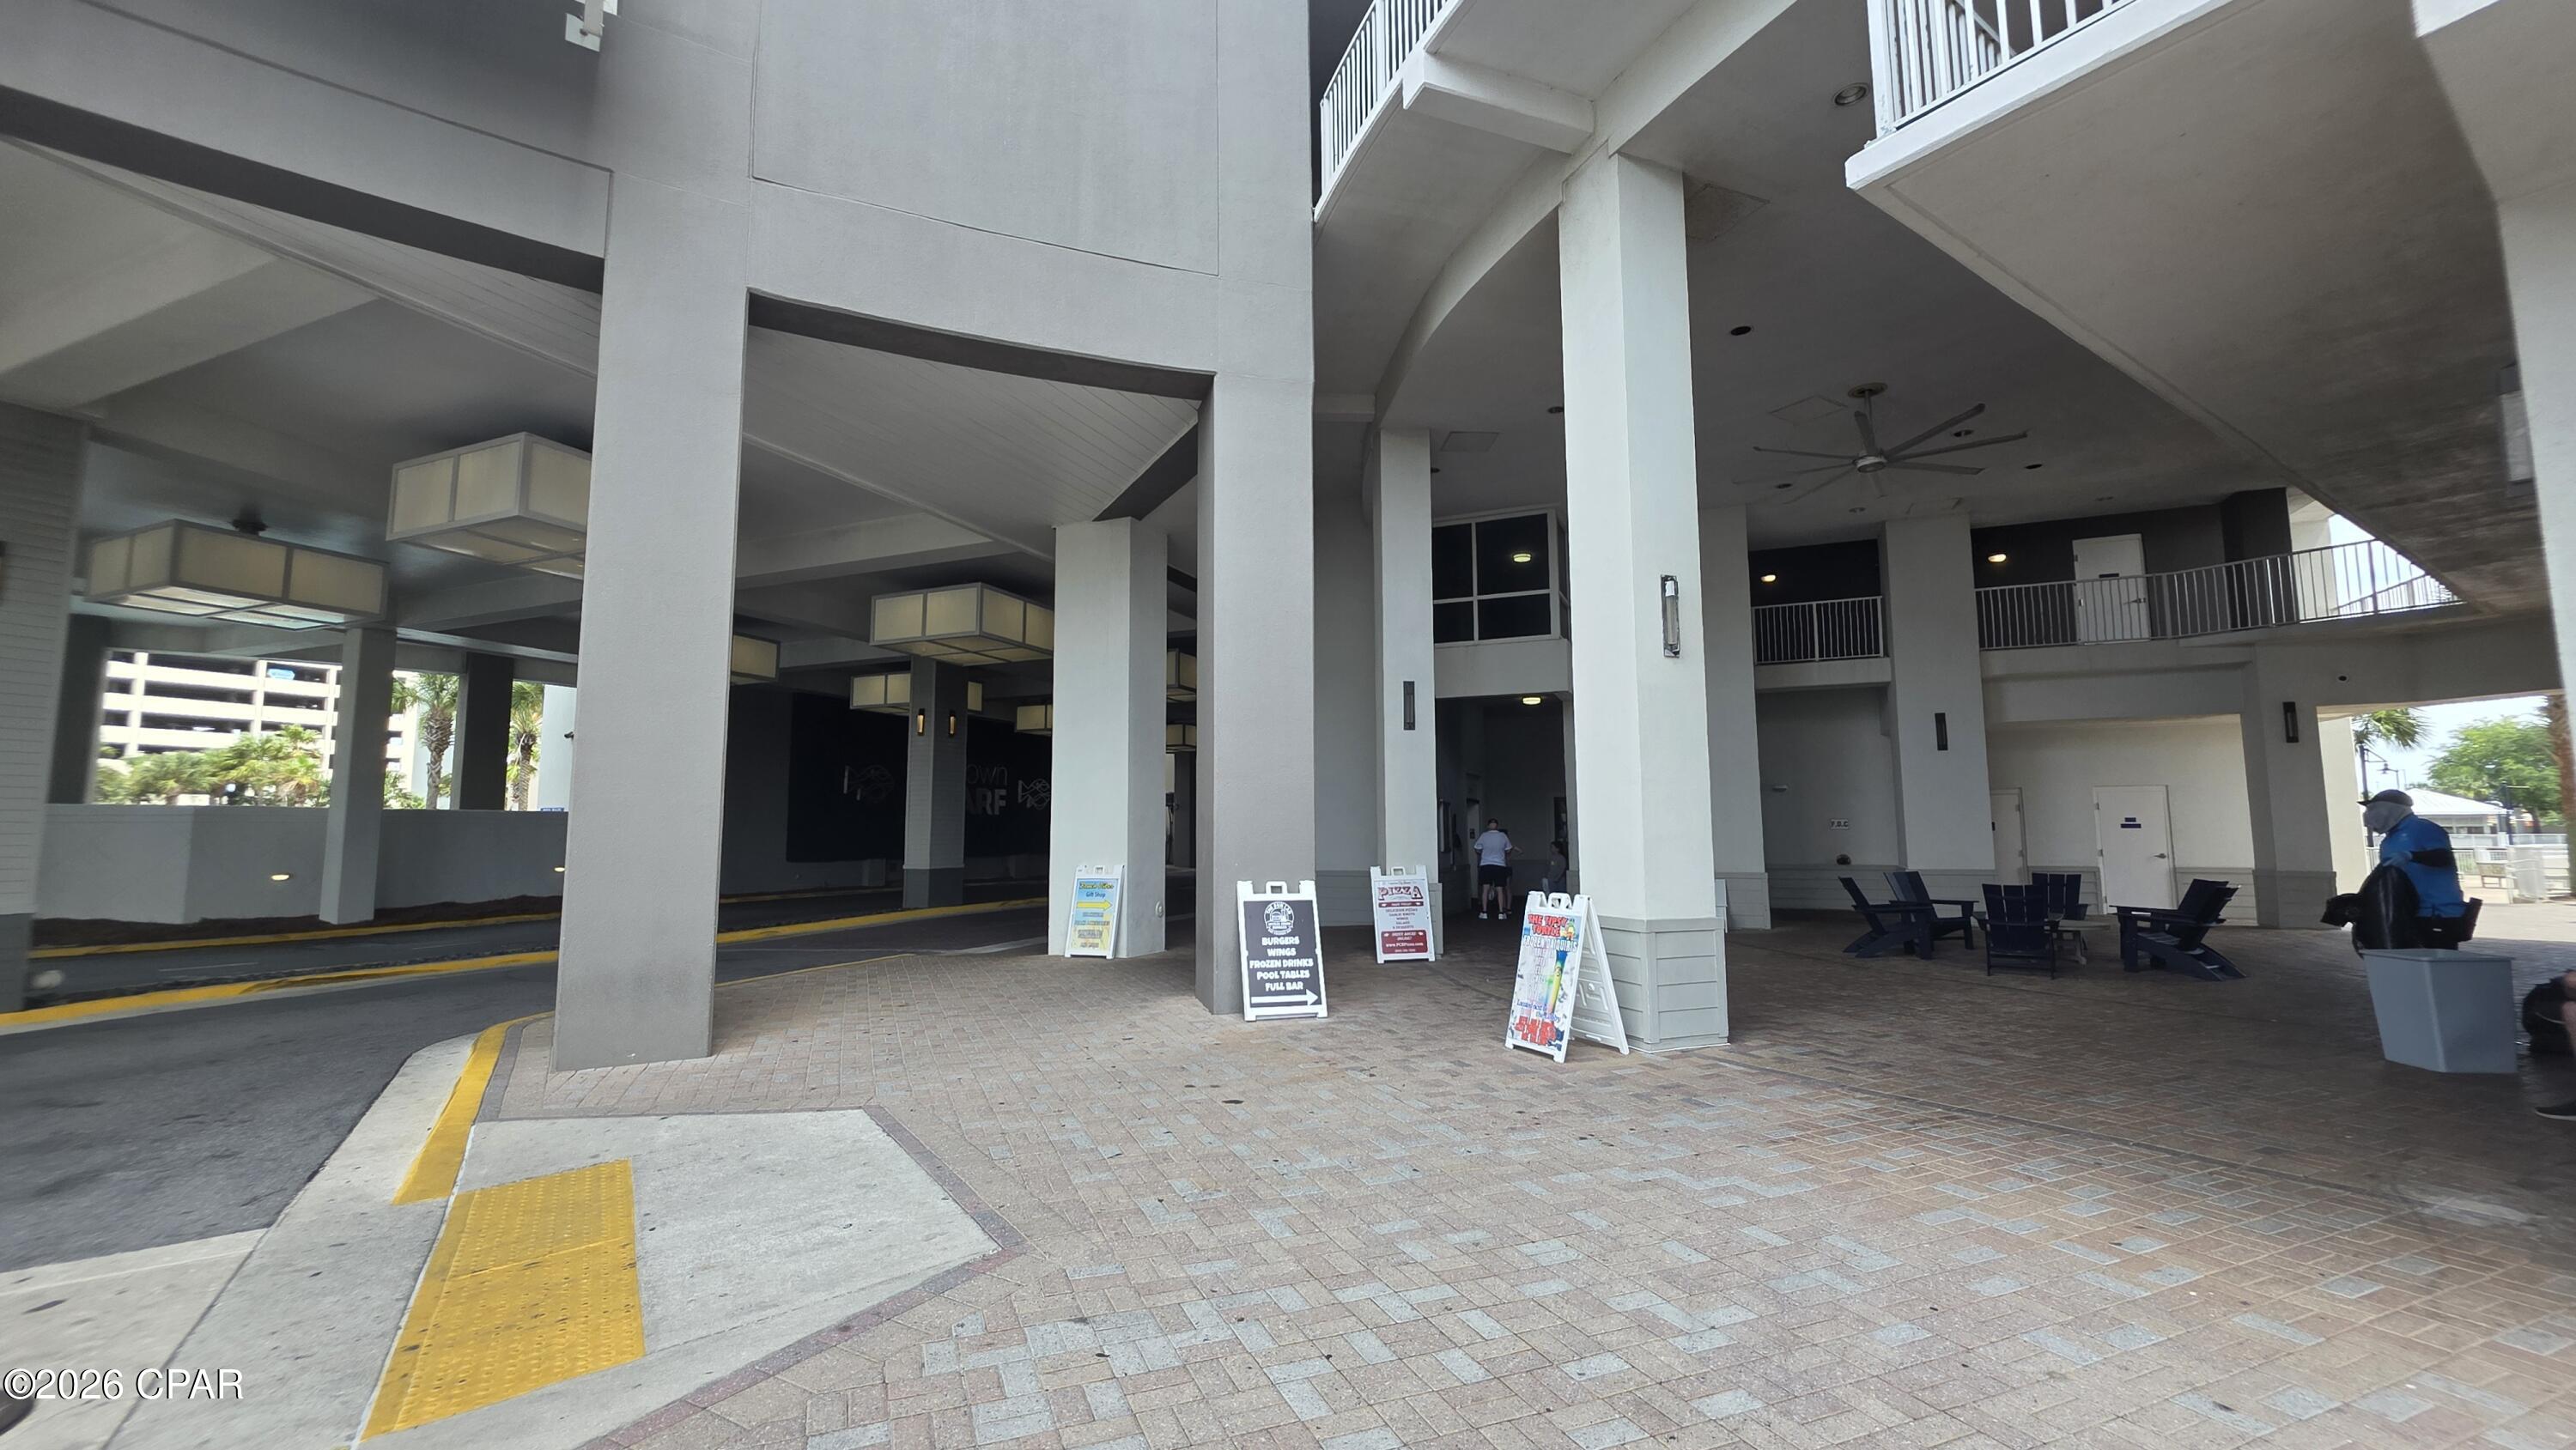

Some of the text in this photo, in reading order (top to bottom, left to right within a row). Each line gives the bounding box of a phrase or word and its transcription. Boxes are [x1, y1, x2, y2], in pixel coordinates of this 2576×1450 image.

[1377, 885, 1424, 901] PIZZA
[1528, 913, 1569, 927] THE TIPSY
[1532, 925, 1561, 937] TURTLE
[1261, 936, 1300, 946] BURGERS
[1267, 947, 1297, 957] WINGS
[1249, 957, 1314, 969] FROZEN DRINKS
[1256, 969, 1310, 980] POOL TABLES
[1265, 980, 1303, 992] FULL BAR
